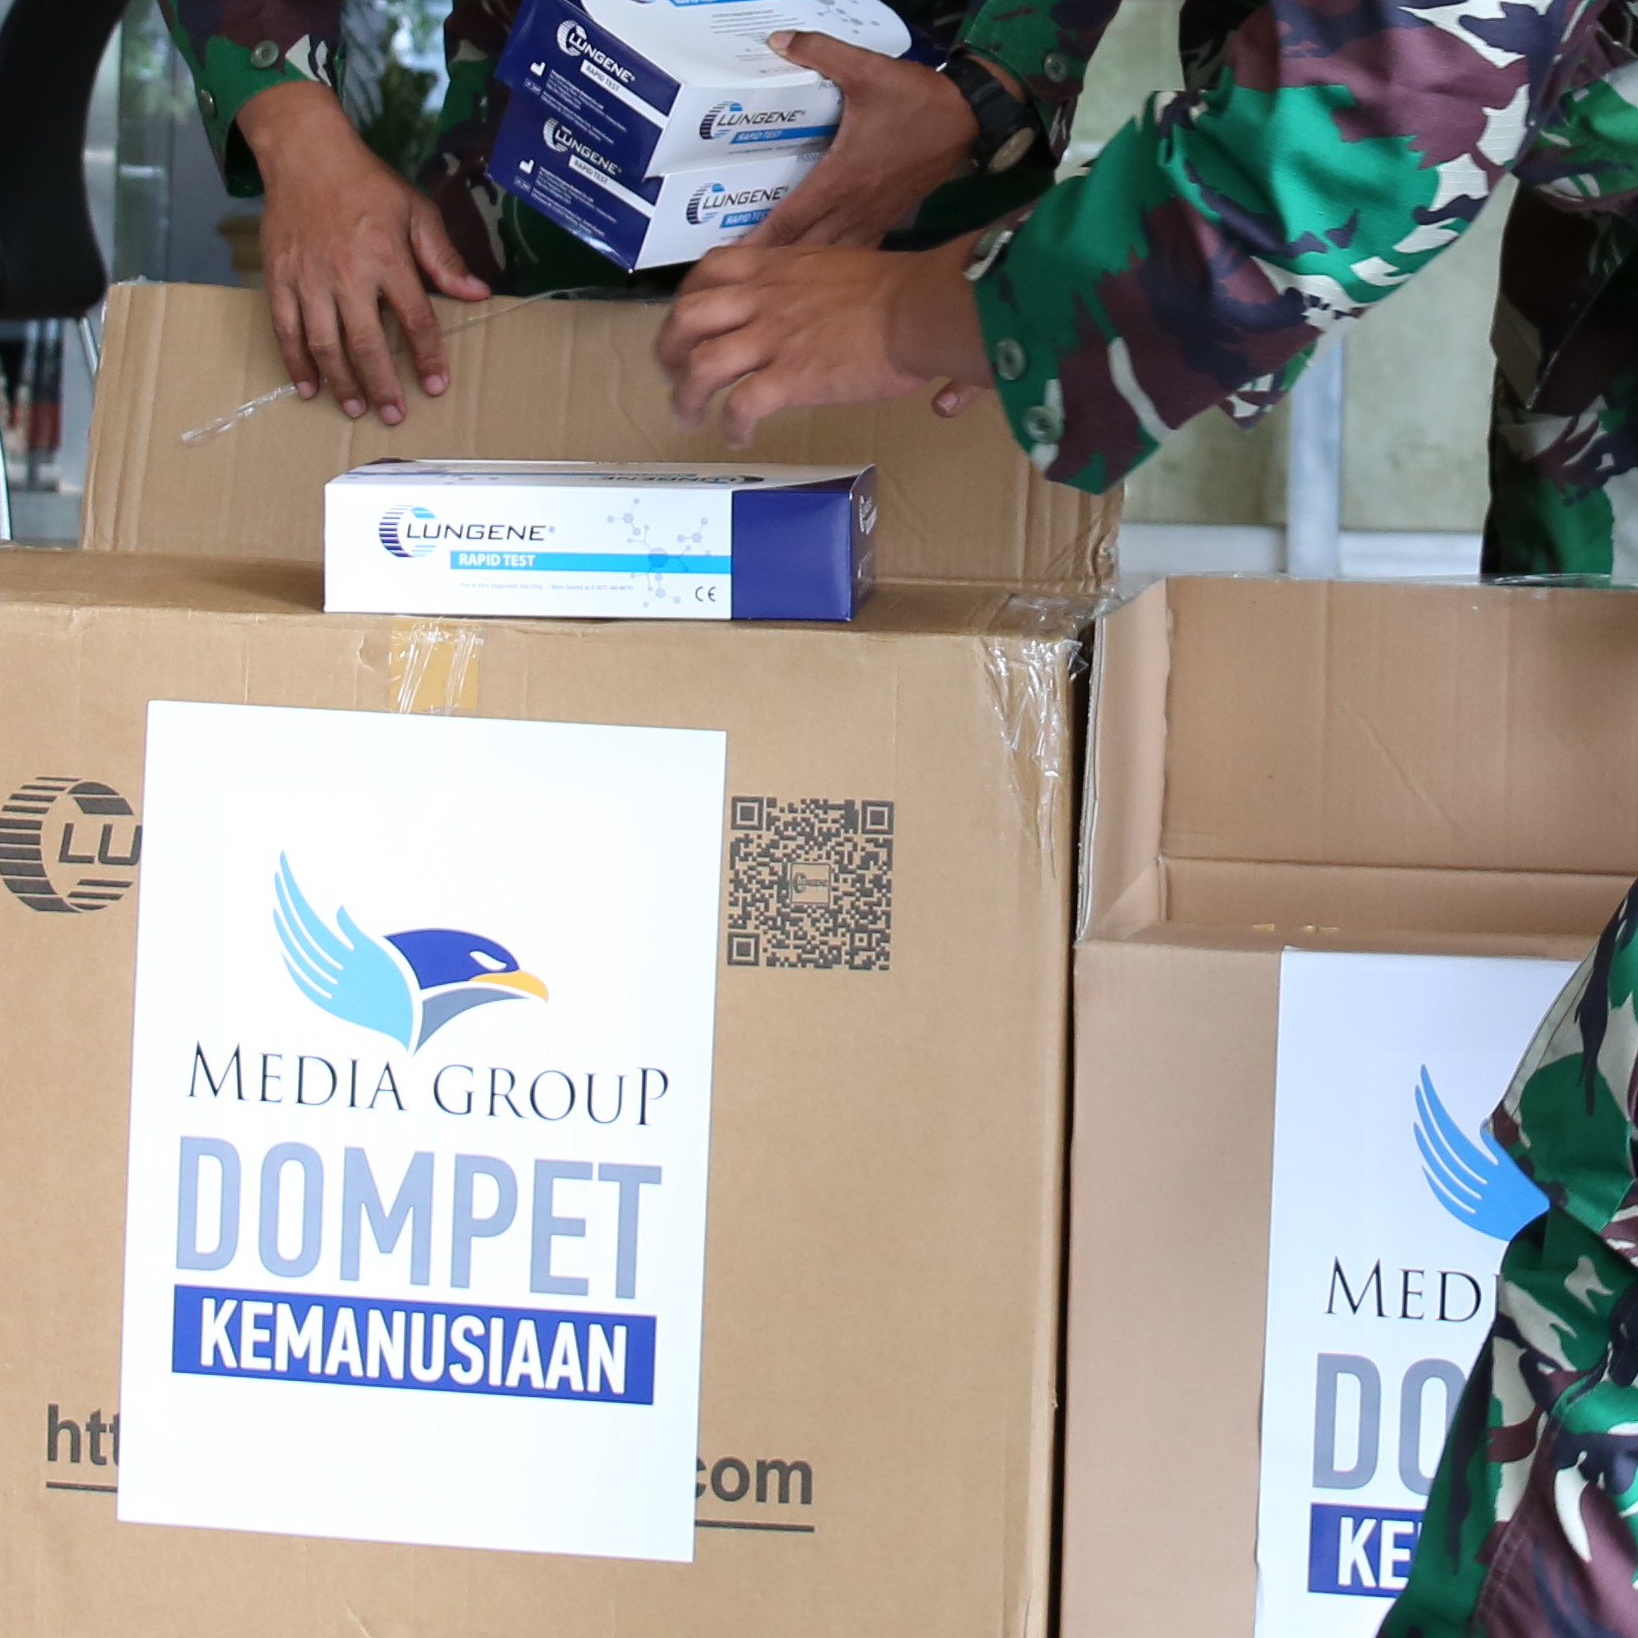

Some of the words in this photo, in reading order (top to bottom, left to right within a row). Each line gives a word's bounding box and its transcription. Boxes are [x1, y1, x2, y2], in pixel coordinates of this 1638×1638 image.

[586, 64, 605, 82] RAPID
[605, 76, 621, 93] TEST
[574, 158, 593, 176] RAPID
[593, 169, 609, 186] TEST
[458, 553, 501, 567] RAPID
[503, 554, 536, 568] TEST
[187, 1039, 410, 1113] MEDIA
[432, 1063, 670, 1126] GROUP
[175, 1134, 663, 1300] DOMPET
[199, 1296, 629, 1395] KEMANUSIAAN
[1338, 1515, 1422, 1591] KE
